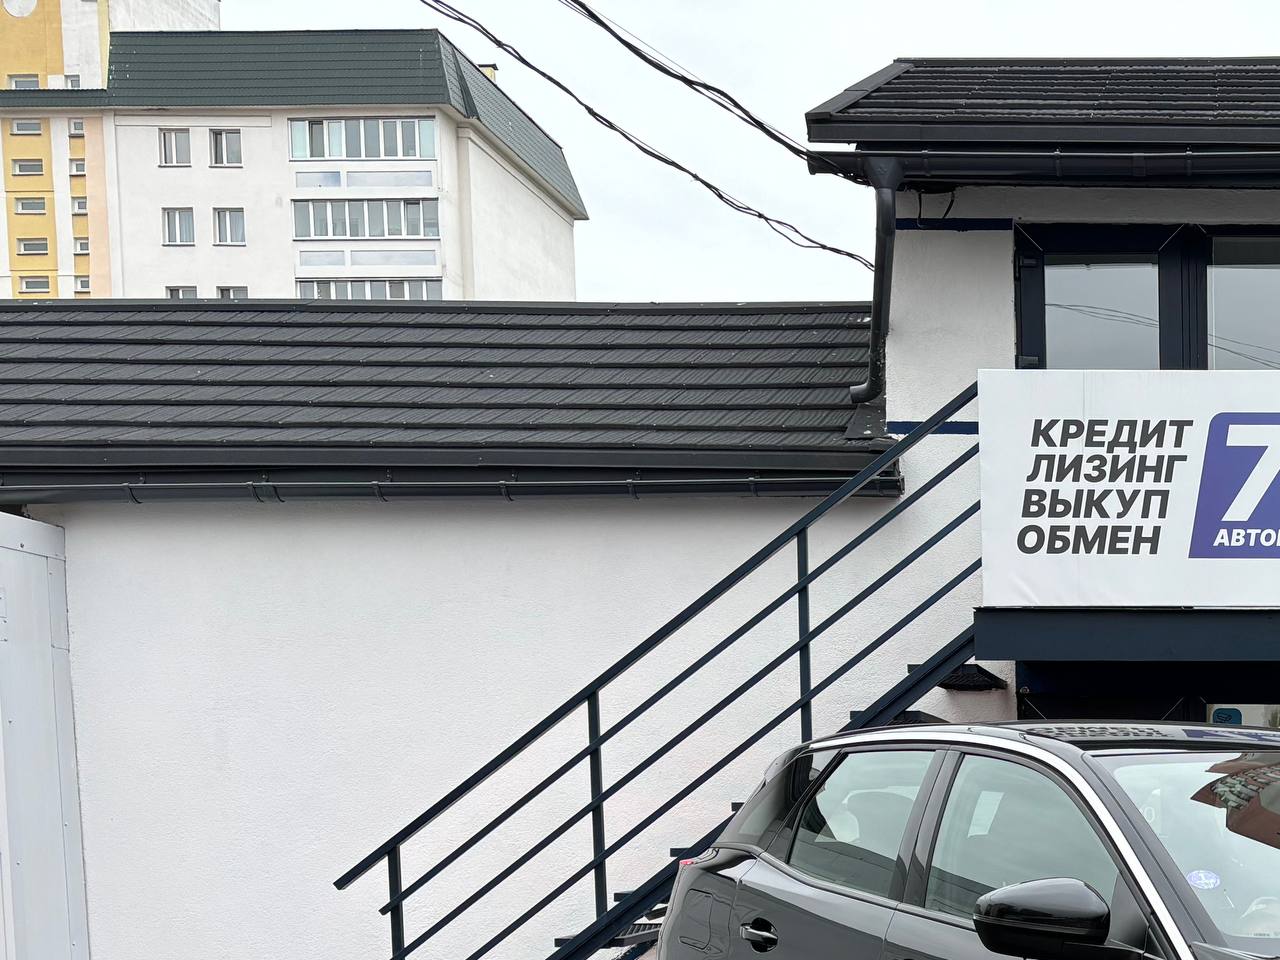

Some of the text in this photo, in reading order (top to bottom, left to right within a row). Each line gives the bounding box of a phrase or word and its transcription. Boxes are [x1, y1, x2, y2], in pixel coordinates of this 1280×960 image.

[1030, 418, 1194, 454] КРЕДИТ
[1025, 453, 1188, 483] ЛИЗИНГ
[1021, 488, 1170, 519] ВЫКУП
[1016, 524, 1162, 555] ОБМЕН
